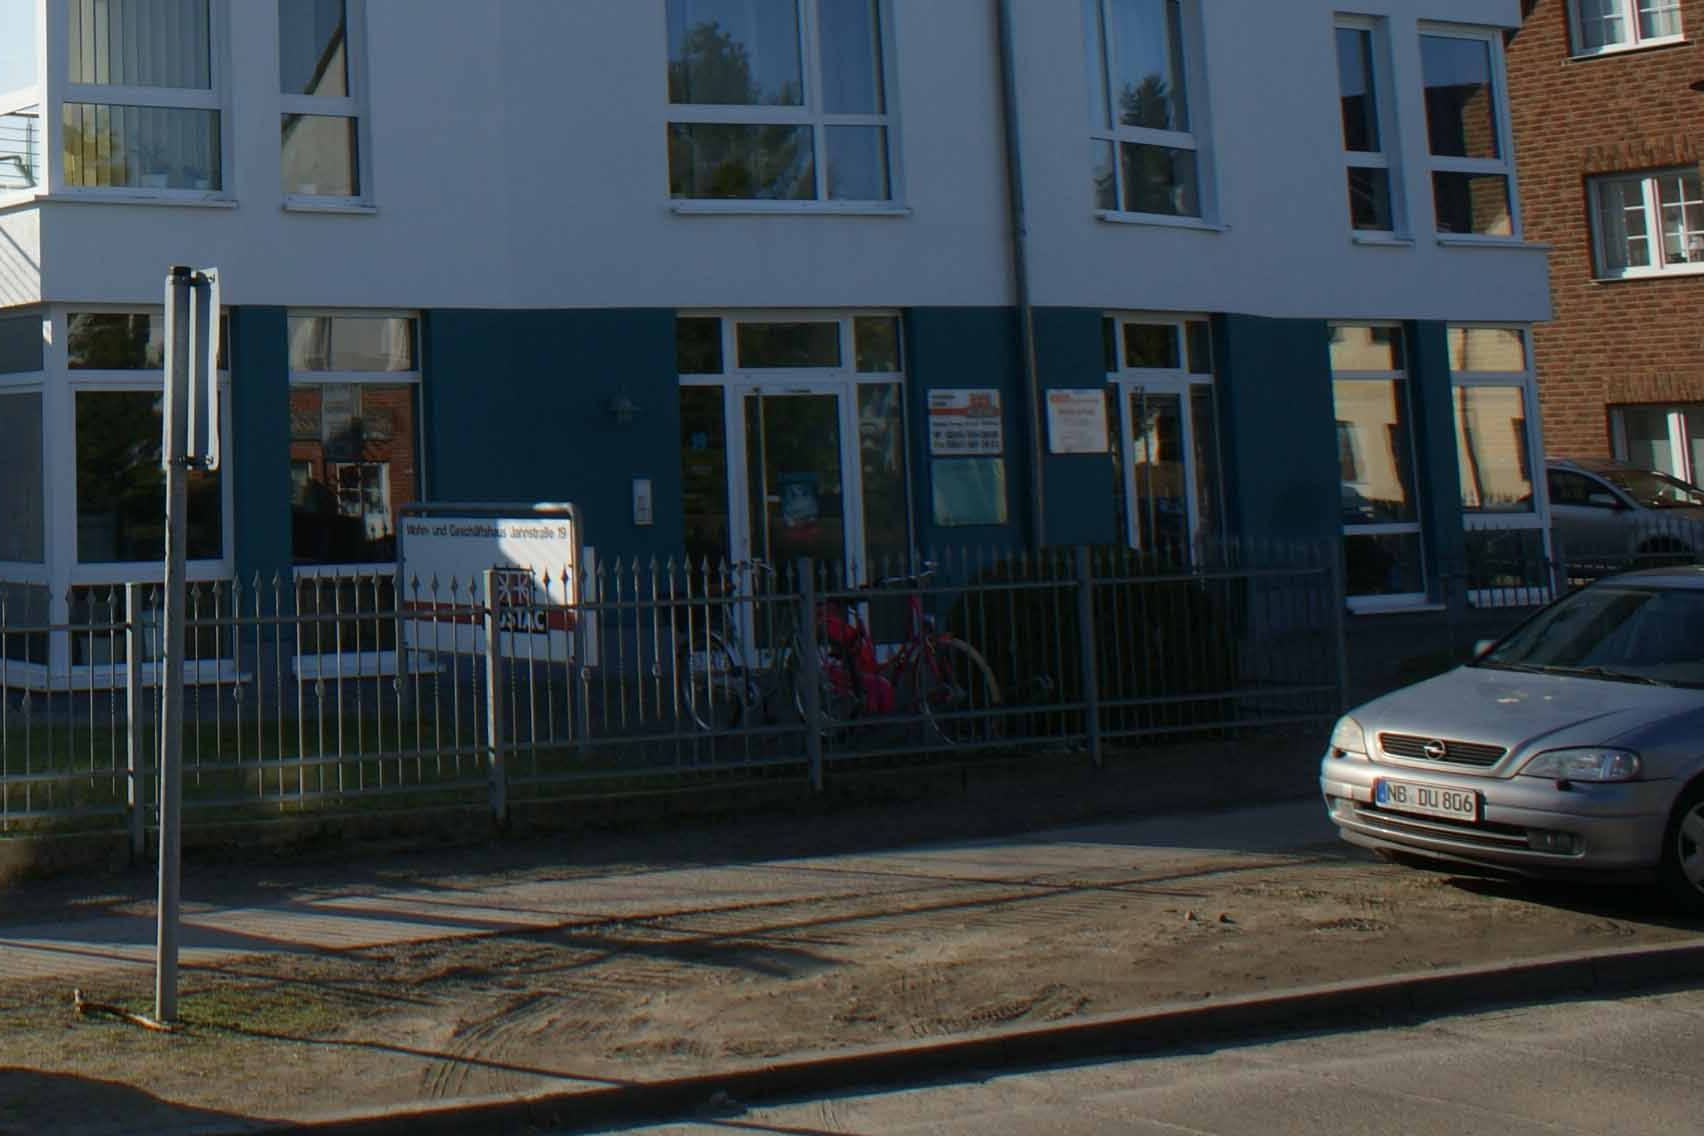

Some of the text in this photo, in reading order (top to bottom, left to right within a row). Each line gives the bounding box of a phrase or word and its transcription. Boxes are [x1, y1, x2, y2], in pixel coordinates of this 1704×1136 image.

[432, 524, 448, 537] und
[1387, 784, 1474, 813] NB DU 806
